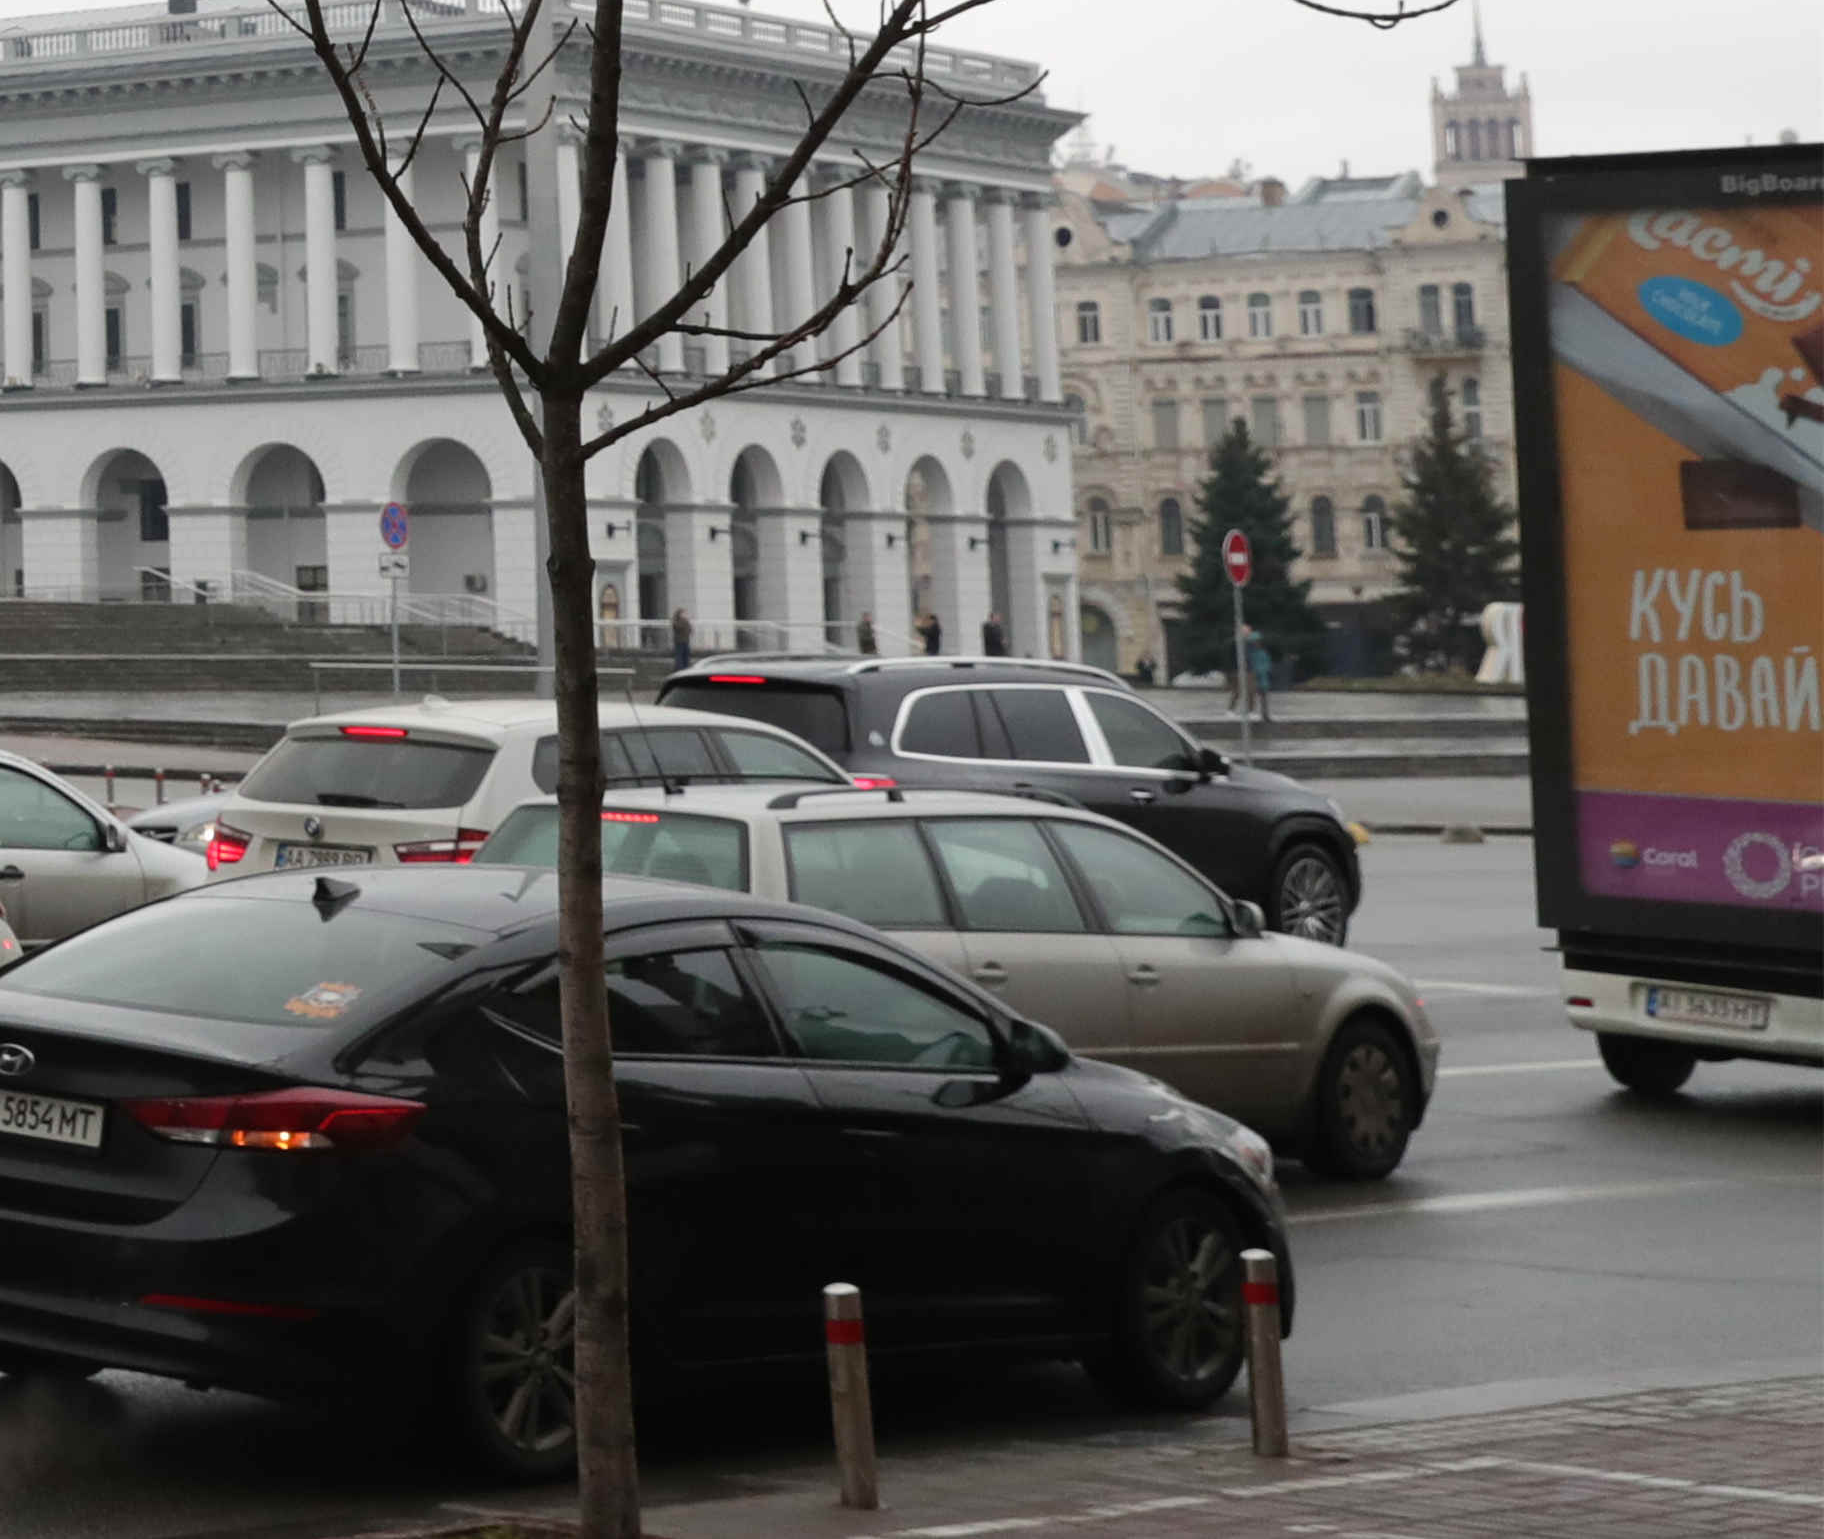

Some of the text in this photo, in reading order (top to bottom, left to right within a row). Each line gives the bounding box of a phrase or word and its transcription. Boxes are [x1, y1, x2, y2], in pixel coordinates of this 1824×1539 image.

[1630, 568, 1764, 643] КУСЬ
[1628, 645, 1822, 736] ДАВАЙ
[2, 1095, 55, 1135] 5854
[58, 1104, 97, 1141] MT
